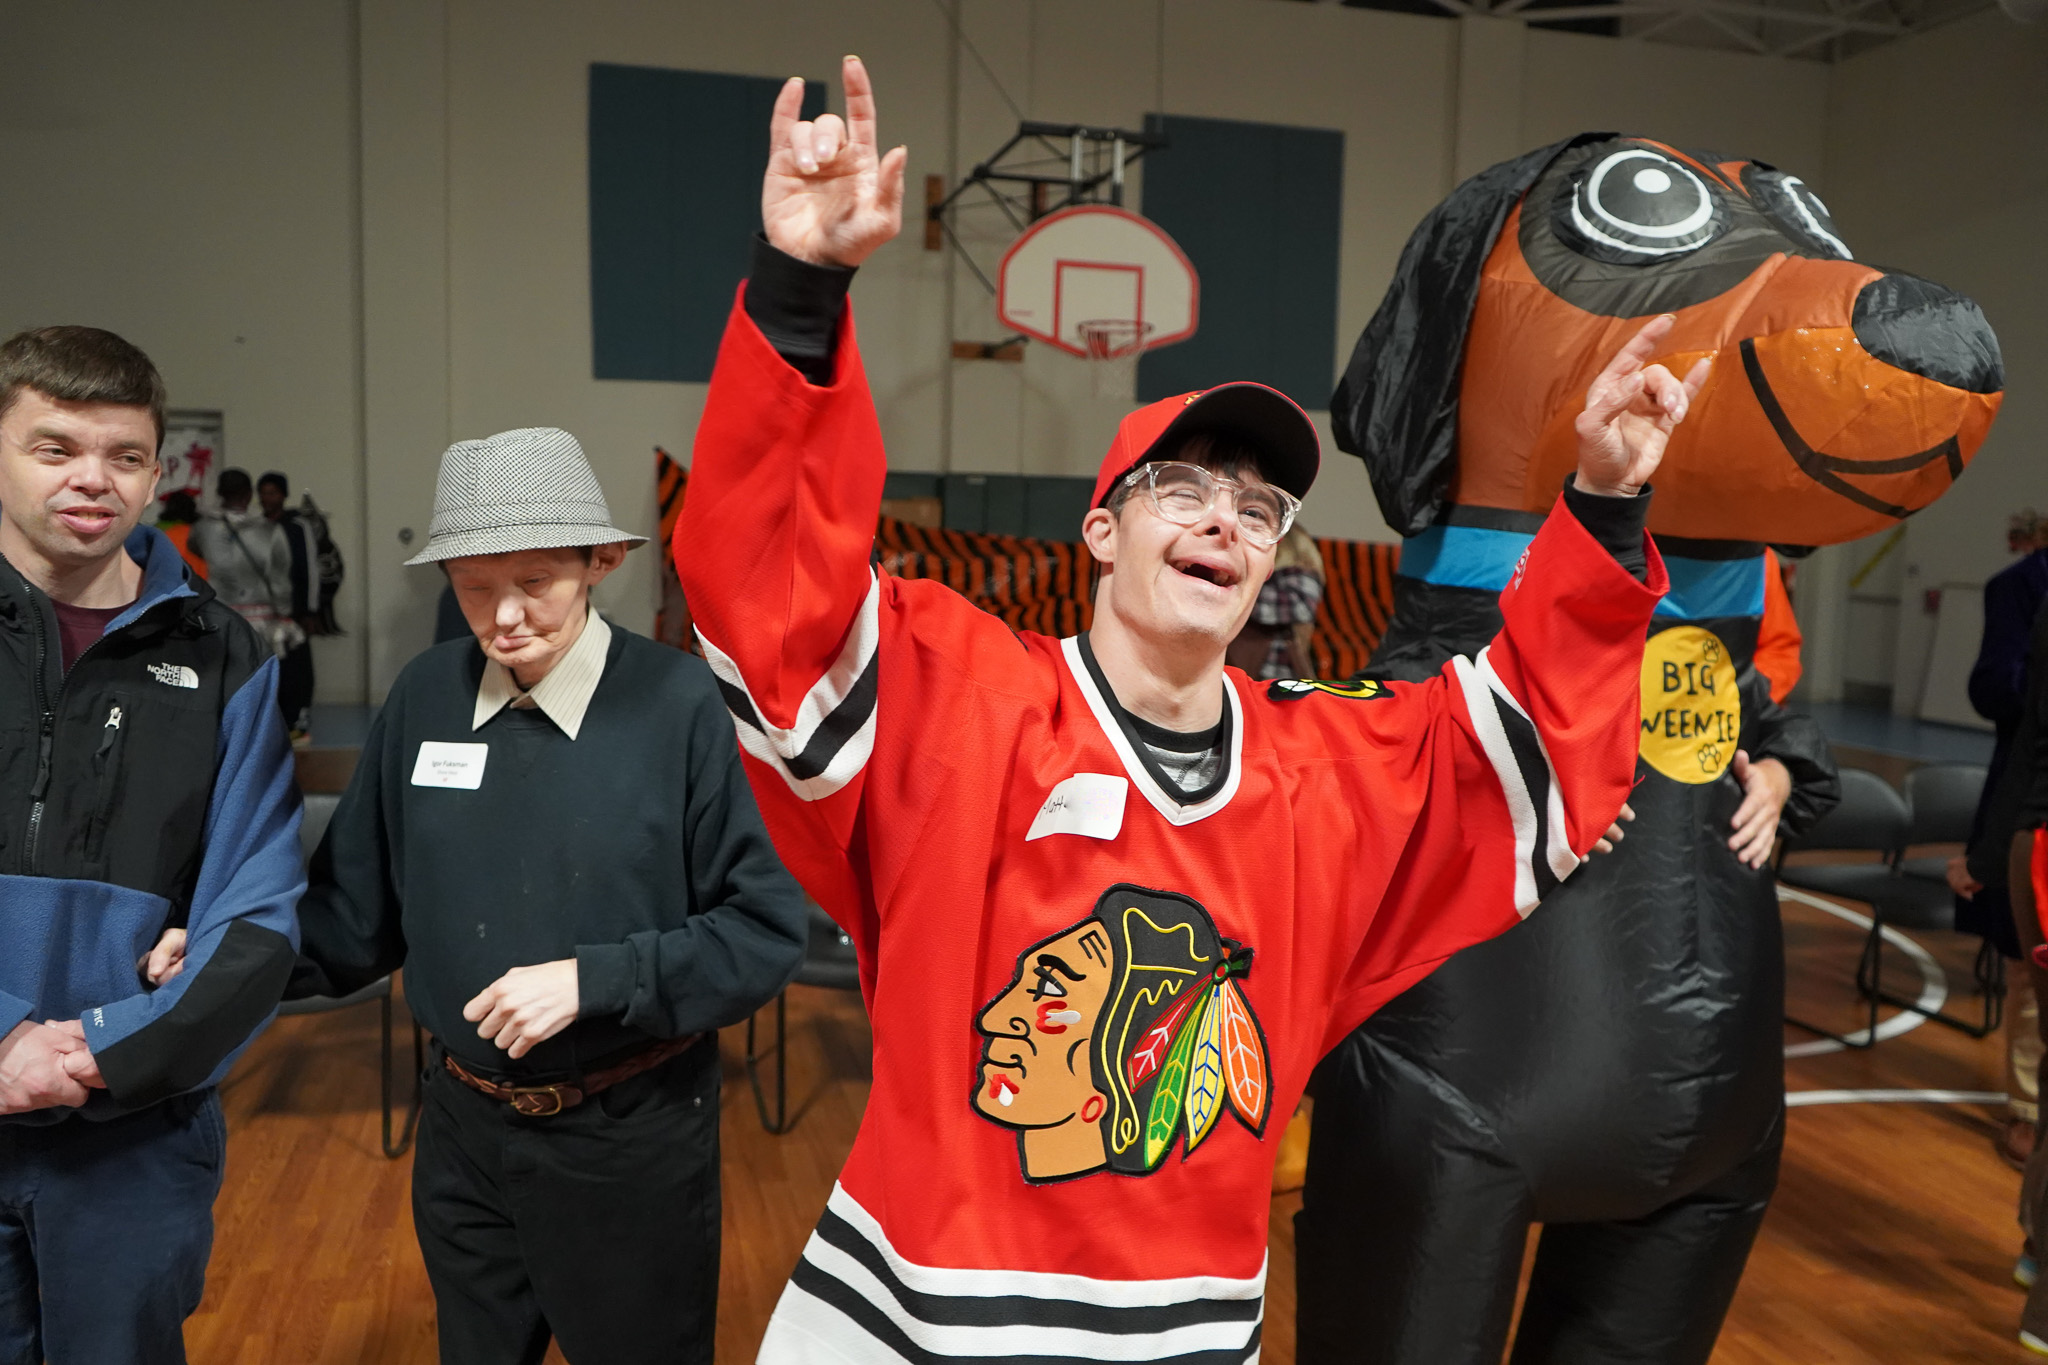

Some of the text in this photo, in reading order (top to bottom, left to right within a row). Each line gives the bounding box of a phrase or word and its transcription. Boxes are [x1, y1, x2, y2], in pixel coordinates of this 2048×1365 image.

[147, 664, 181, 680] NORTH
[161, 662, 181, 672] THE
[155, 674, 181, 687] FACE
[1662, 661, 1716, 697] BIG
